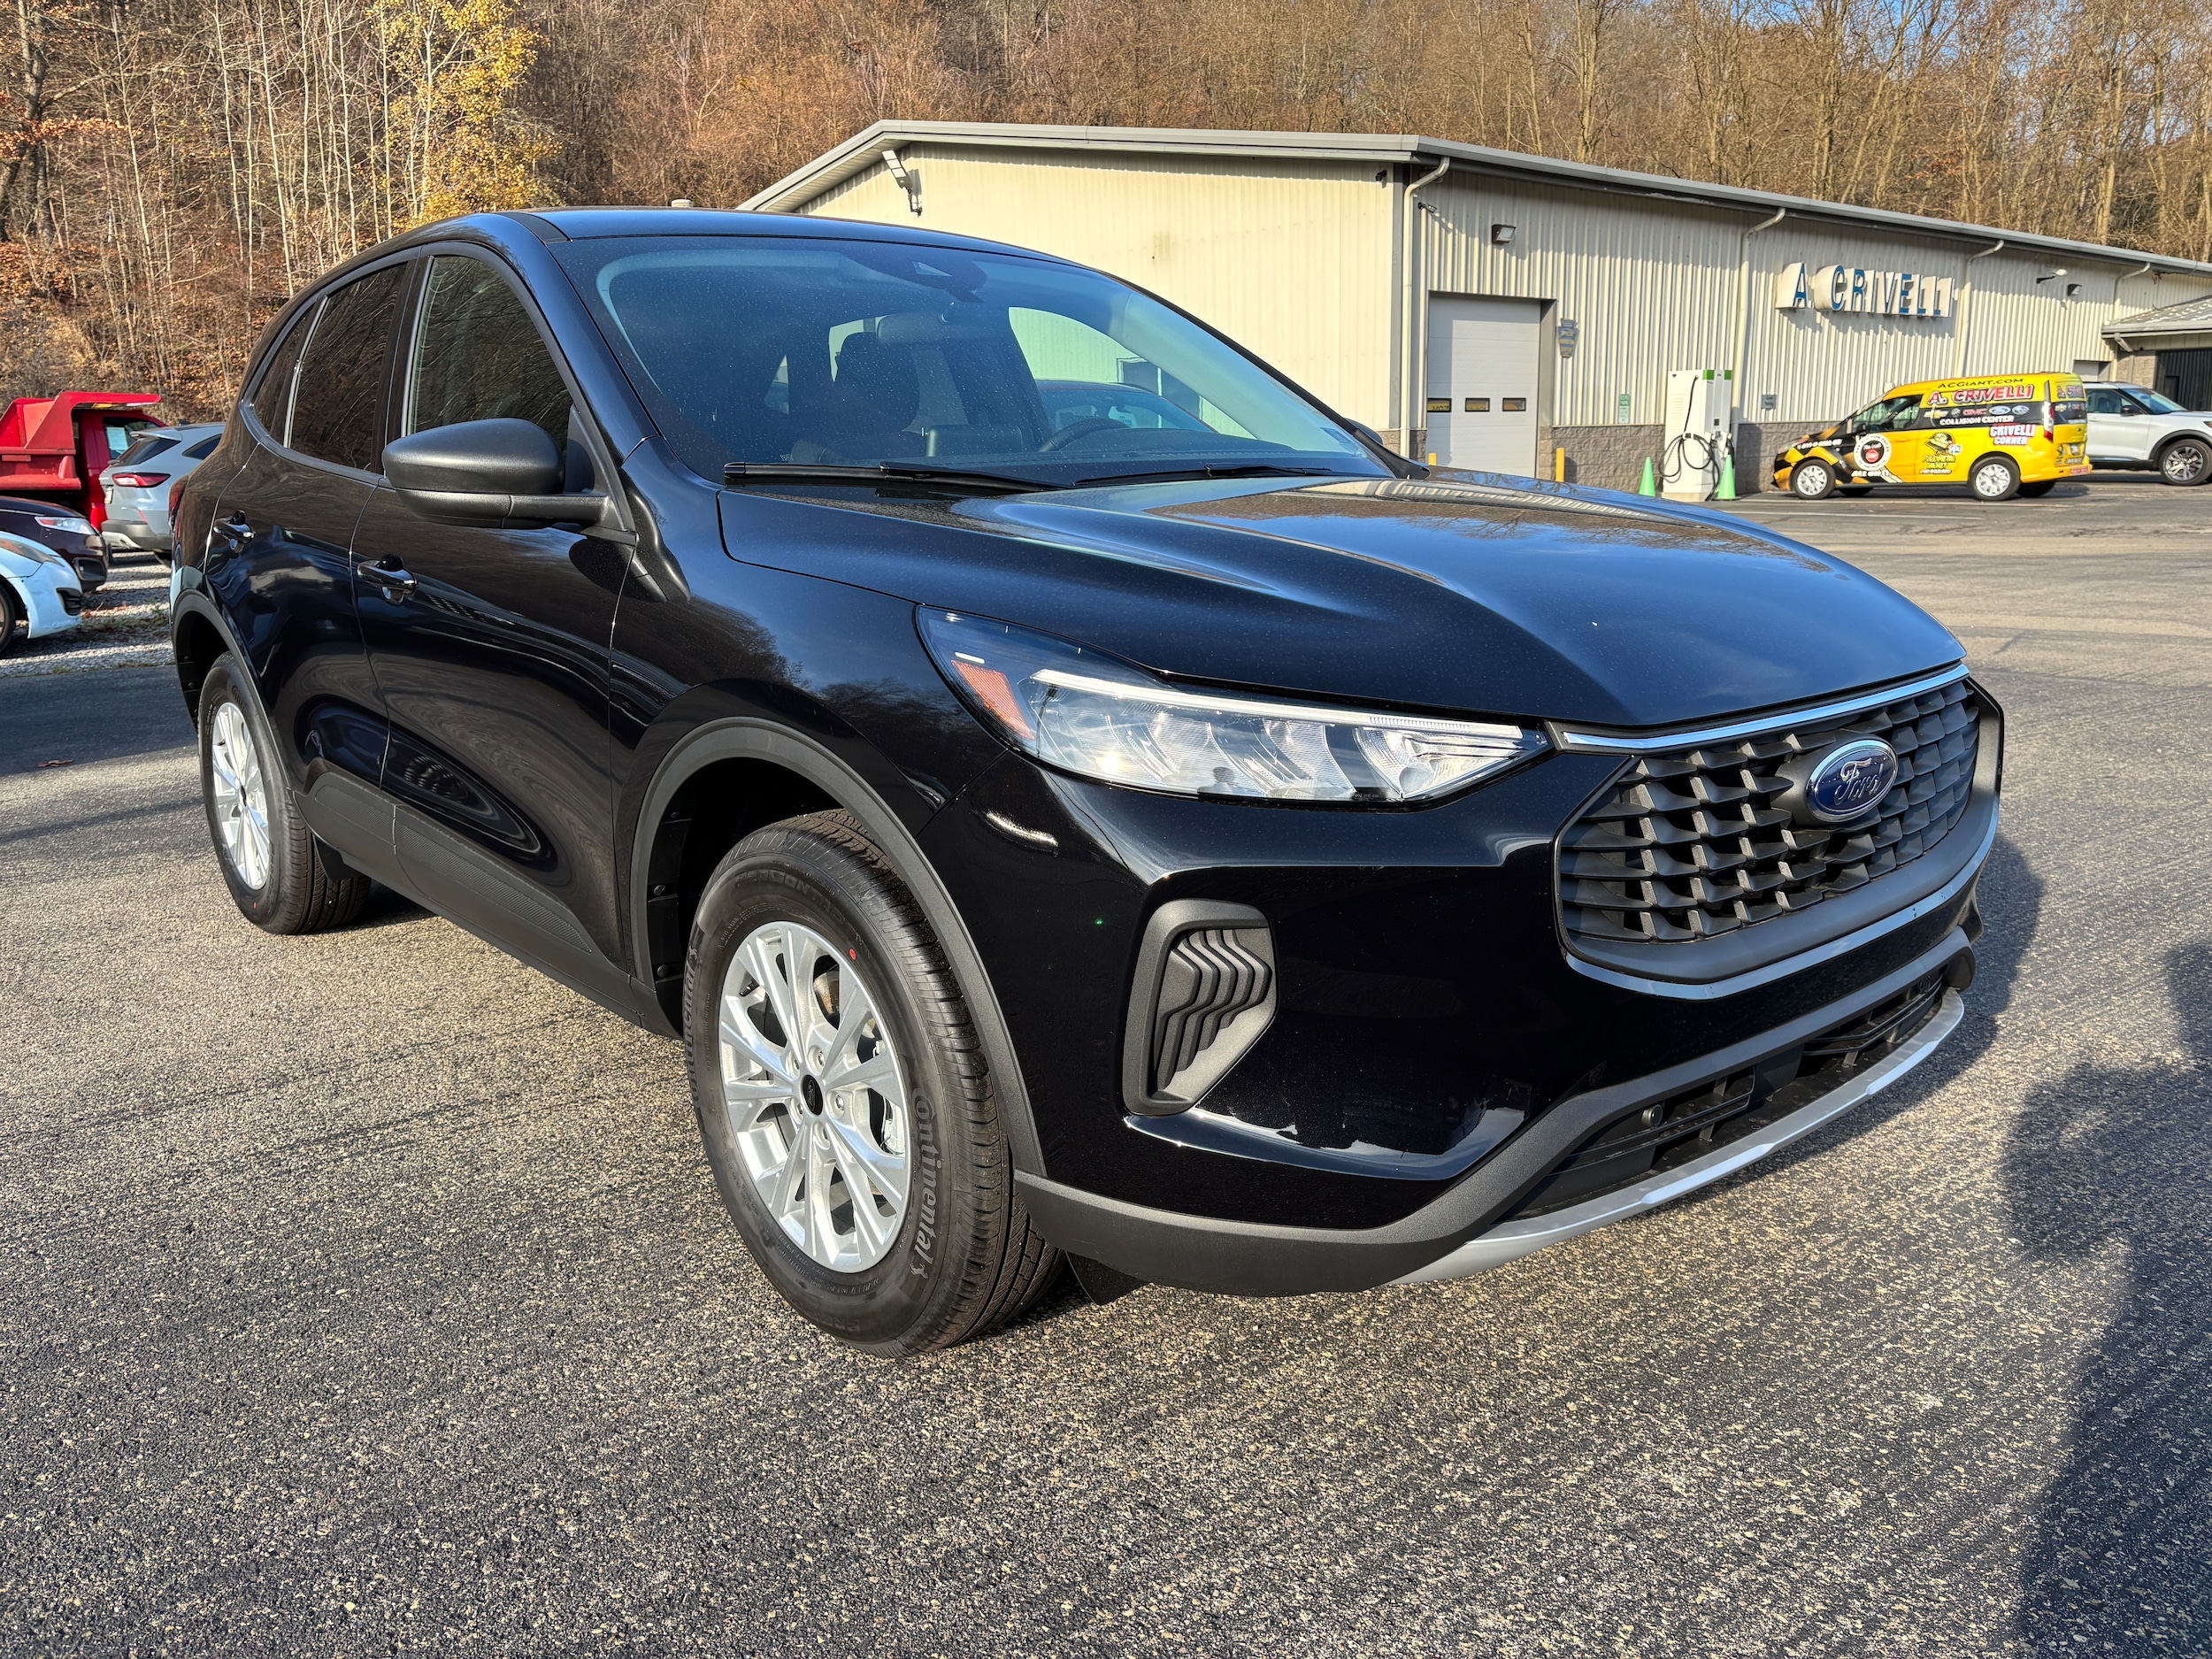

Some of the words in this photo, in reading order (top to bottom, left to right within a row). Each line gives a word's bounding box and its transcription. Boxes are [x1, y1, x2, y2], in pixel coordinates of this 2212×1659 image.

[1781, 262, 1807, 308] A
[1938, 378, 2024, 388] ACGIANT.COM
[1952, 384, 2035, 403] CRIVELLI
[1939, 416, 1981, 426] COLLISION
[1982, 415, 2015, 424] CENTER
[1834, 757, 1884, 804] Ford
[911, 1087, 941, 1265] Continental
